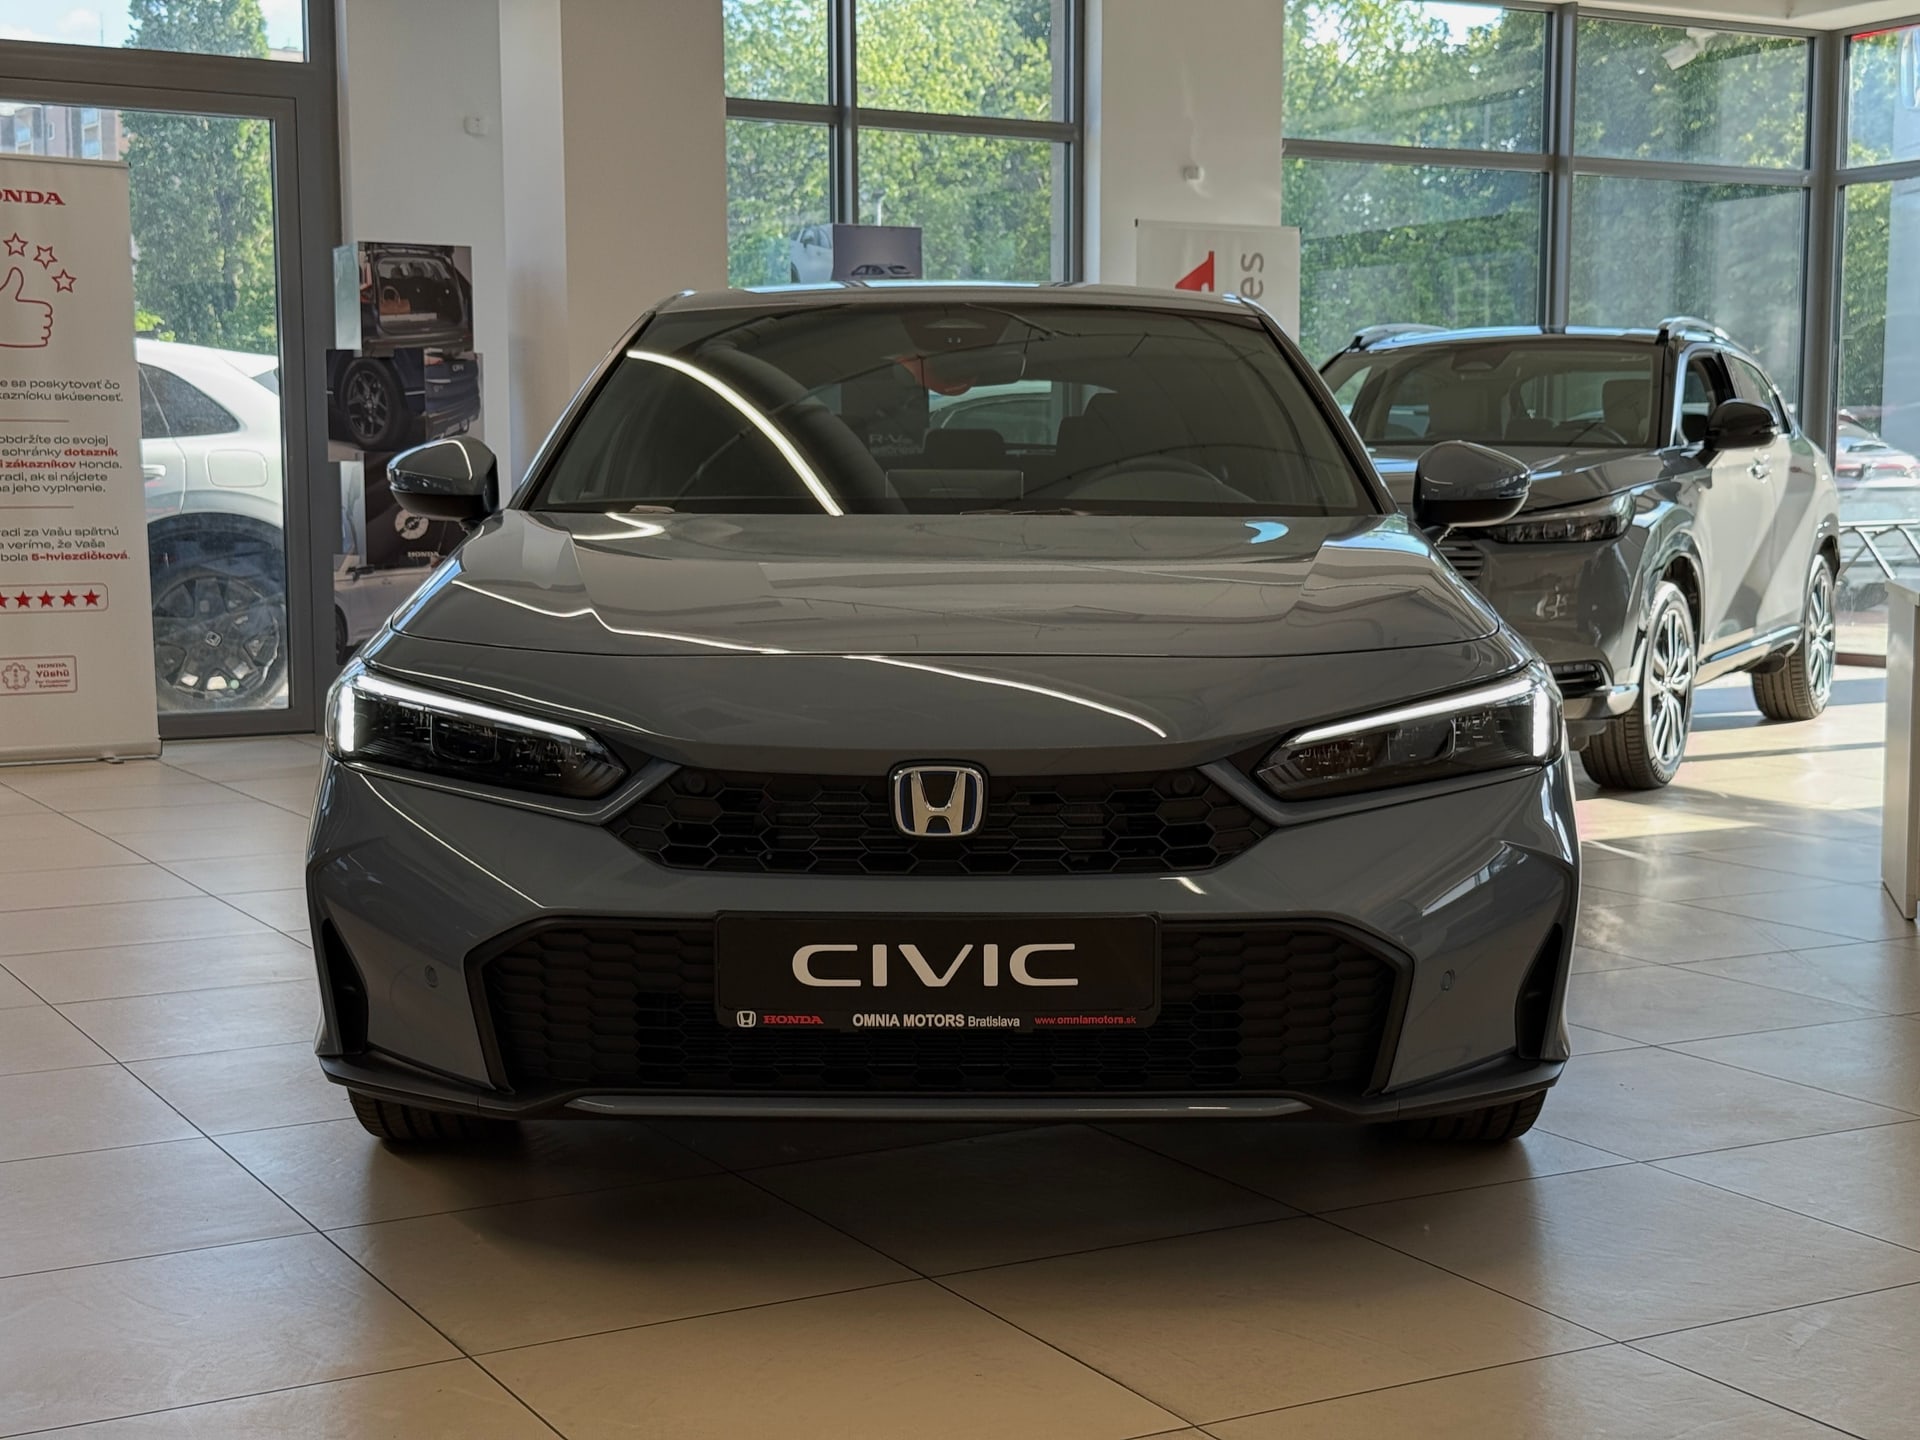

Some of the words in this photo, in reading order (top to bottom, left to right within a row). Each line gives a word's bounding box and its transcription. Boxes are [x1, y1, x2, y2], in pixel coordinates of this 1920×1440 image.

[0, 189, 66, 206] NDA
[11, 379, 27, 388] sa
[30, 379, 102, 391] poskytovať
[104, 380, 120, 390] čo
[54, 391, 124, 402] skúsenosť.
[53, 435, 70, 444] do
[72, 434, 109, 447] svojej
[2, 445, 62, 459] schránky
[64, 447, 119, 457] dotazník
[5, 459, 77, 468] zákazníkov
[79, 460, 123, 469] Honda.
[30, 472, 46, 481] ak
[47, 471, 58, 481] si
[60, 471, 108, 484] nájdete
[11, 483, 41, 495] jeho
[42, 483, 106, 495] vyplnenie.
[0, 527, 21, 537] adi
[23, 529, 39, 537] za
[41, 526, 72, 537] Vašu
[74, 525, 120, 538] spätnú
[7, 539, 55, 550] veríme,
[57, 539, 72, 549] že
[74, 538, 106, 548] Vaša
[0, 553, 29, 562] bola
[791, 943, 1079, 988] CIVIC
[762, 1015, 824, 1025] HONDA
[852, 1012, 901, 1028] OMNIA
[902, 1012, 966, 1028] MOTORS
[967, 1015, 1021, 1028] Bratislava
[1034, 1014, 1137, 1025] www.omniamotors.sk
